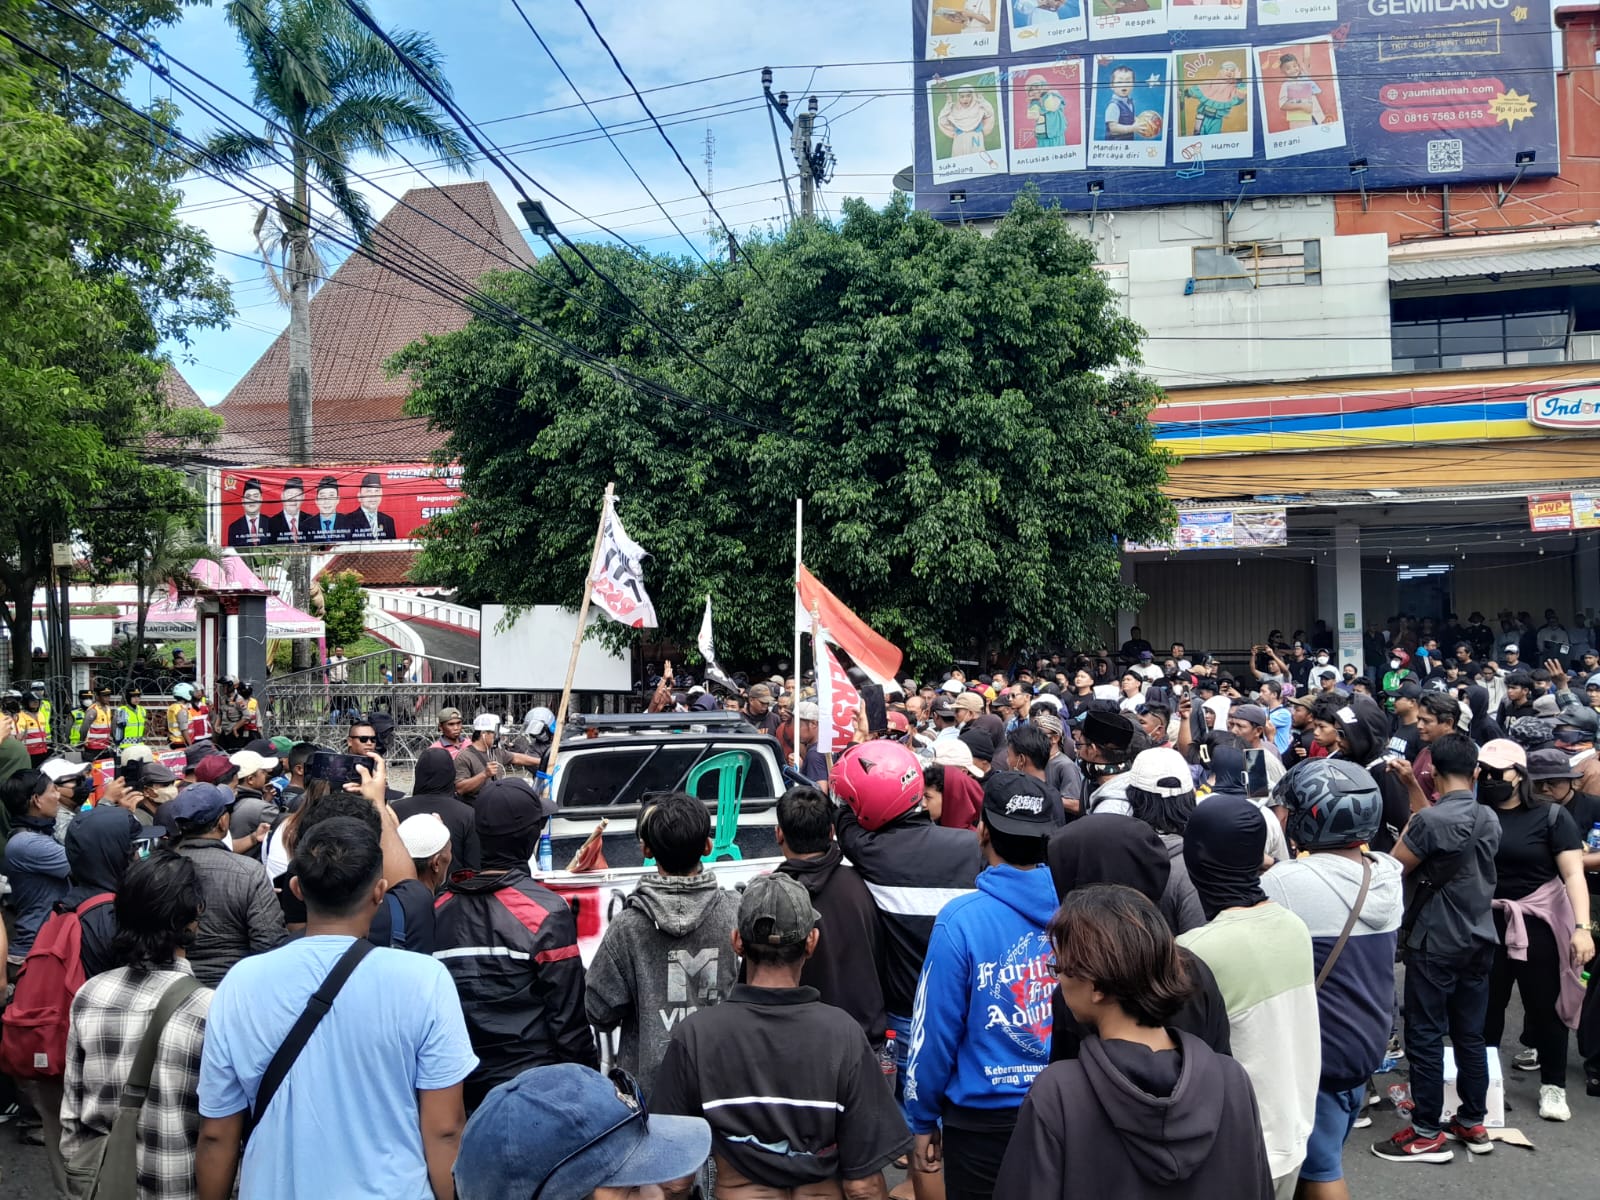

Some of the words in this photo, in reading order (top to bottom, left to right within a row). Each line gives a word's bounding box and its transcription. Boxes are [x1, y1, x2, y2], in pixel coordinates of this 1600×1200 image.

[1294, 4, 1331, 14] Loyalitas
[1125, 18, 1156, 28] Respek
[973, 38, 989, 46] Adil
[1402, 86, 1494, 99] yaumifatimah.com
[1404, 113, 1429, 123] 0815
[1458, 110, 1483, 119] 6155
[1273, 139, 1300, 149] Berani
[1092, 152, 1123, 160] percaya
[1537, 501, 1562, 513] PWP
[977, 954, 1053, 991] Forti
[659, 1006, 698, 1032] VI
